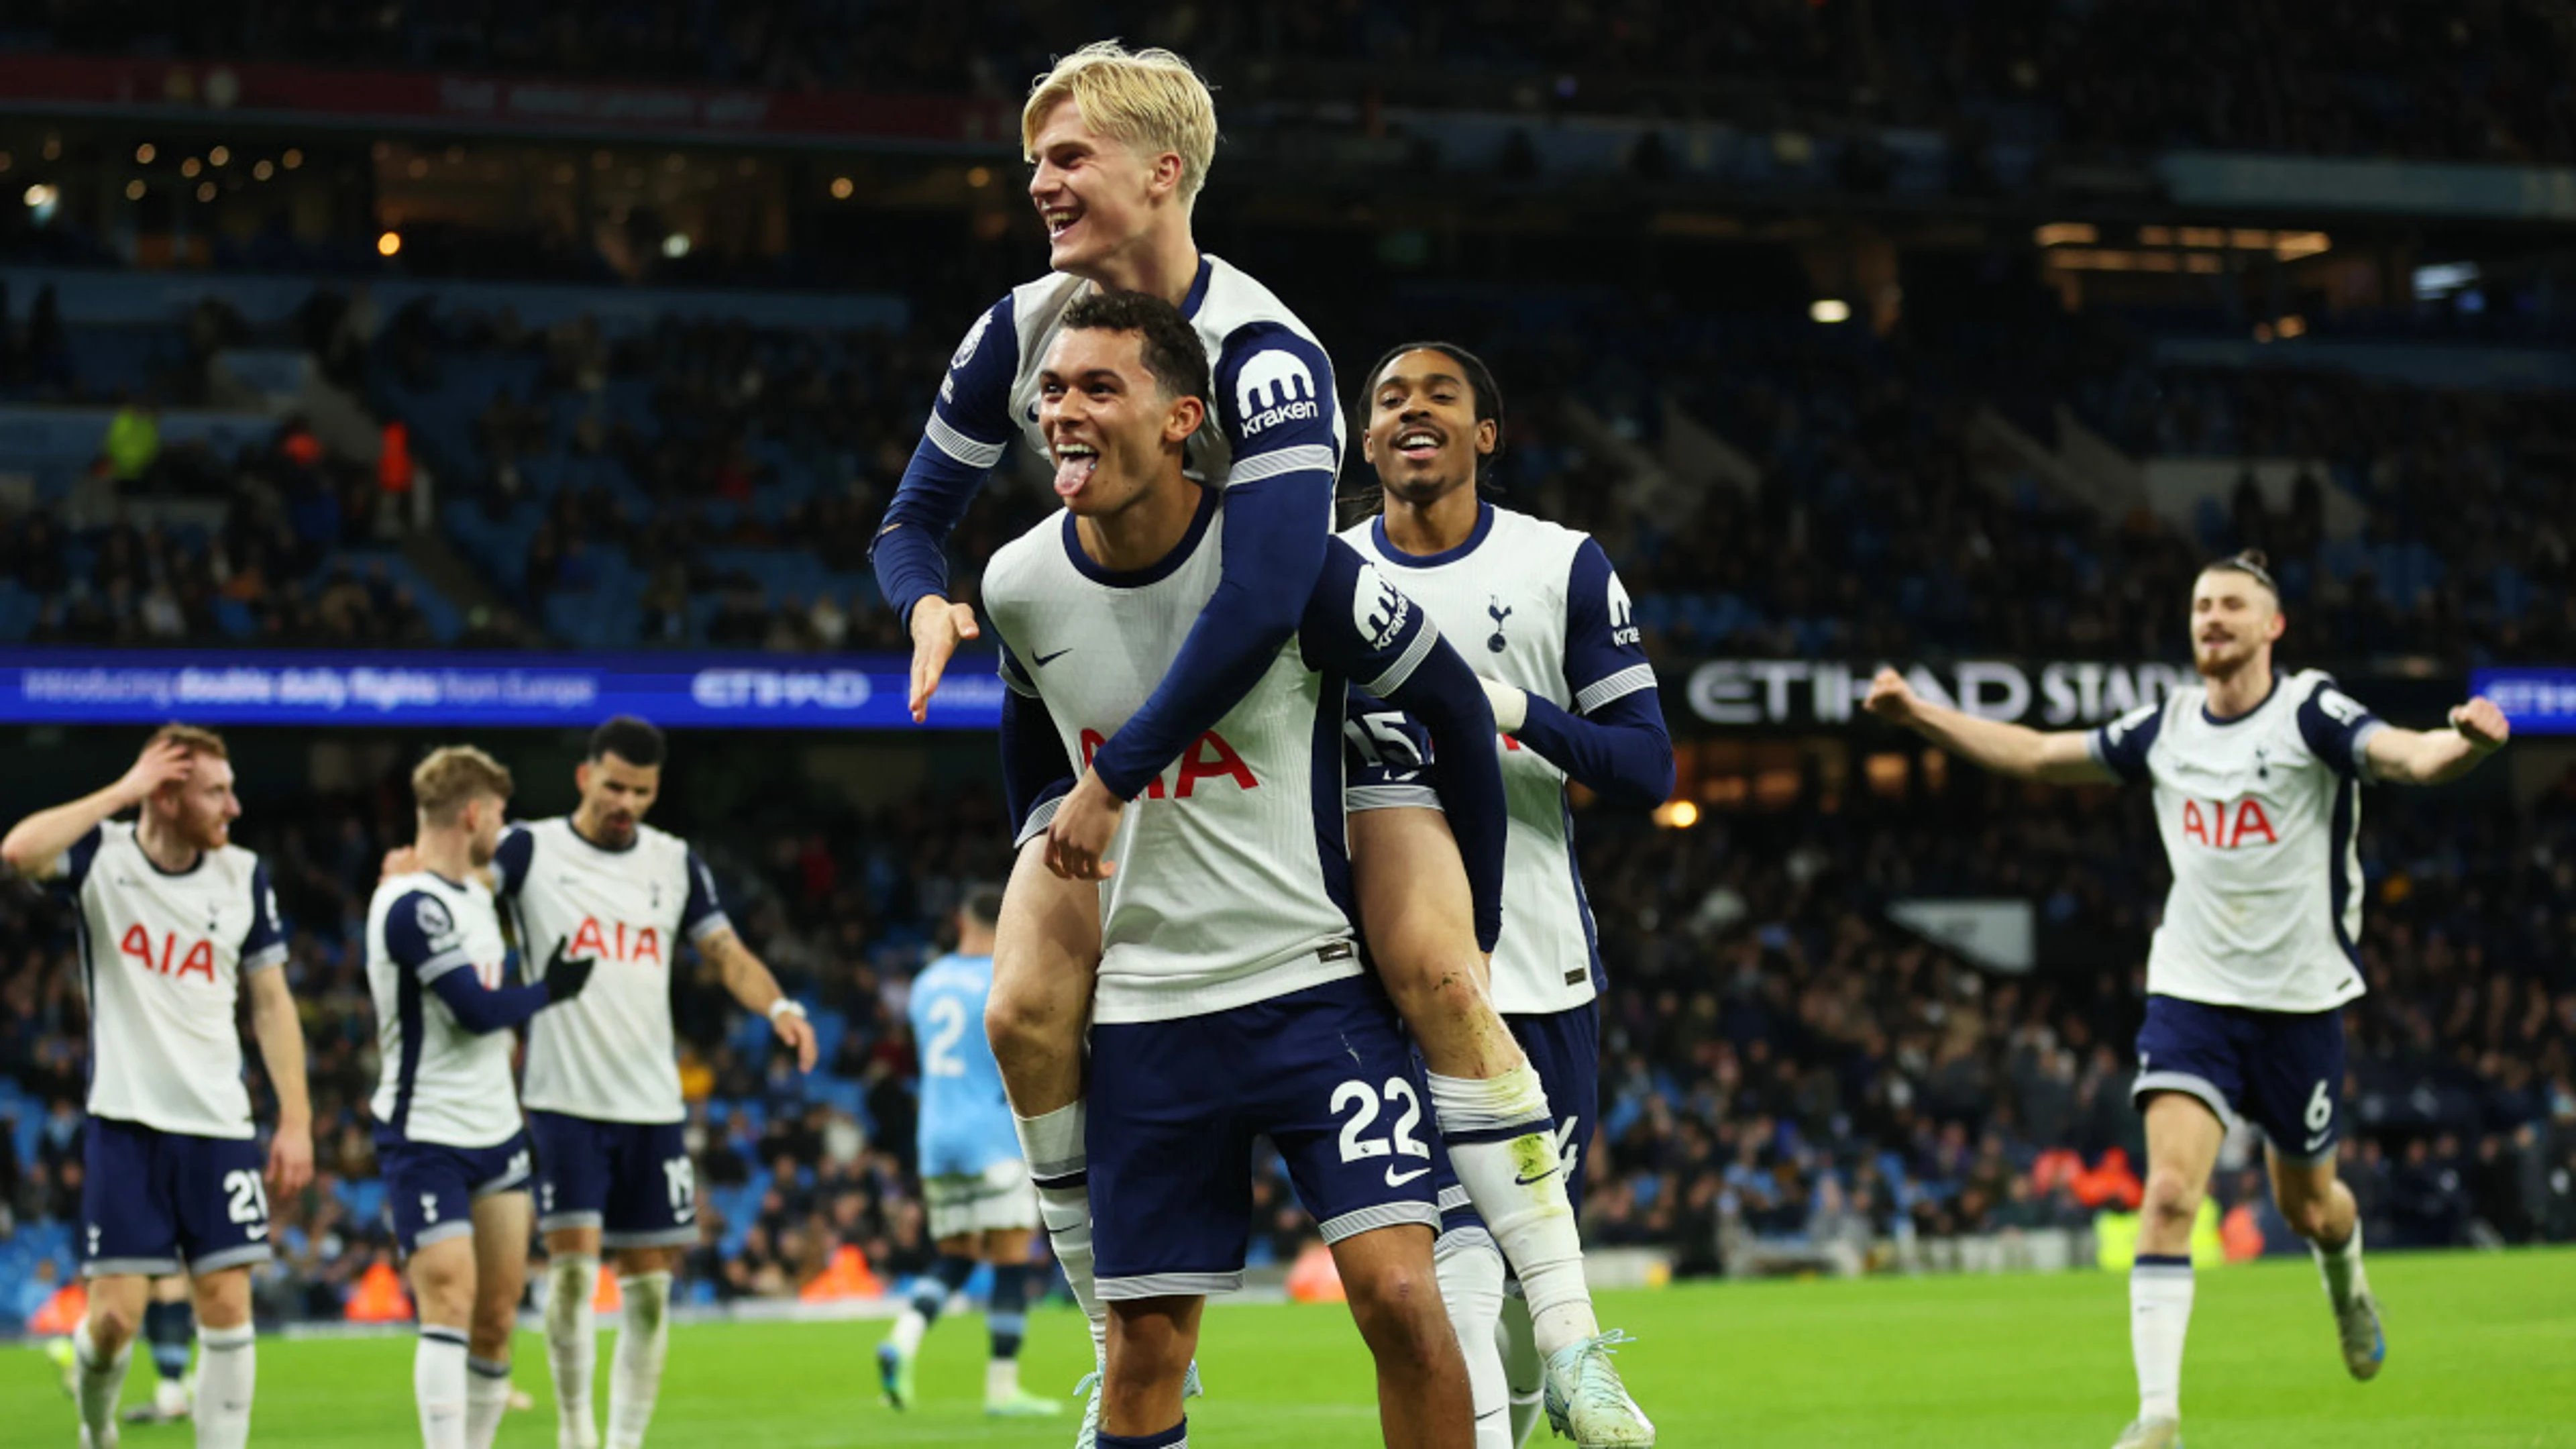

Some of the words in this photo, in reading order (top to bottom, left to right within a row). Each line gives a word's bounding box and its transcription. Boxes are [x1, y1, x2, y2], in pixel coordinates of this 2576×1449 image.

[1240, 401, 1318, 439] kraken
[1613, 627, 1640, 647] kra
[690, 669, 871, 708] ETIHAD
[2043, 661, 2199, 724] STAD
[1344, 711, 1424, 767] 15
[2184, 797, 2278, 848] AIA
[120, 922, 215, 983] AIA
[569, 914, 661, 966] AIA
[925, 997, 967, 1077] 2
[1330, 1077, 1431, 1163] 22
[2304, 1079, 2332, 1132] 6
